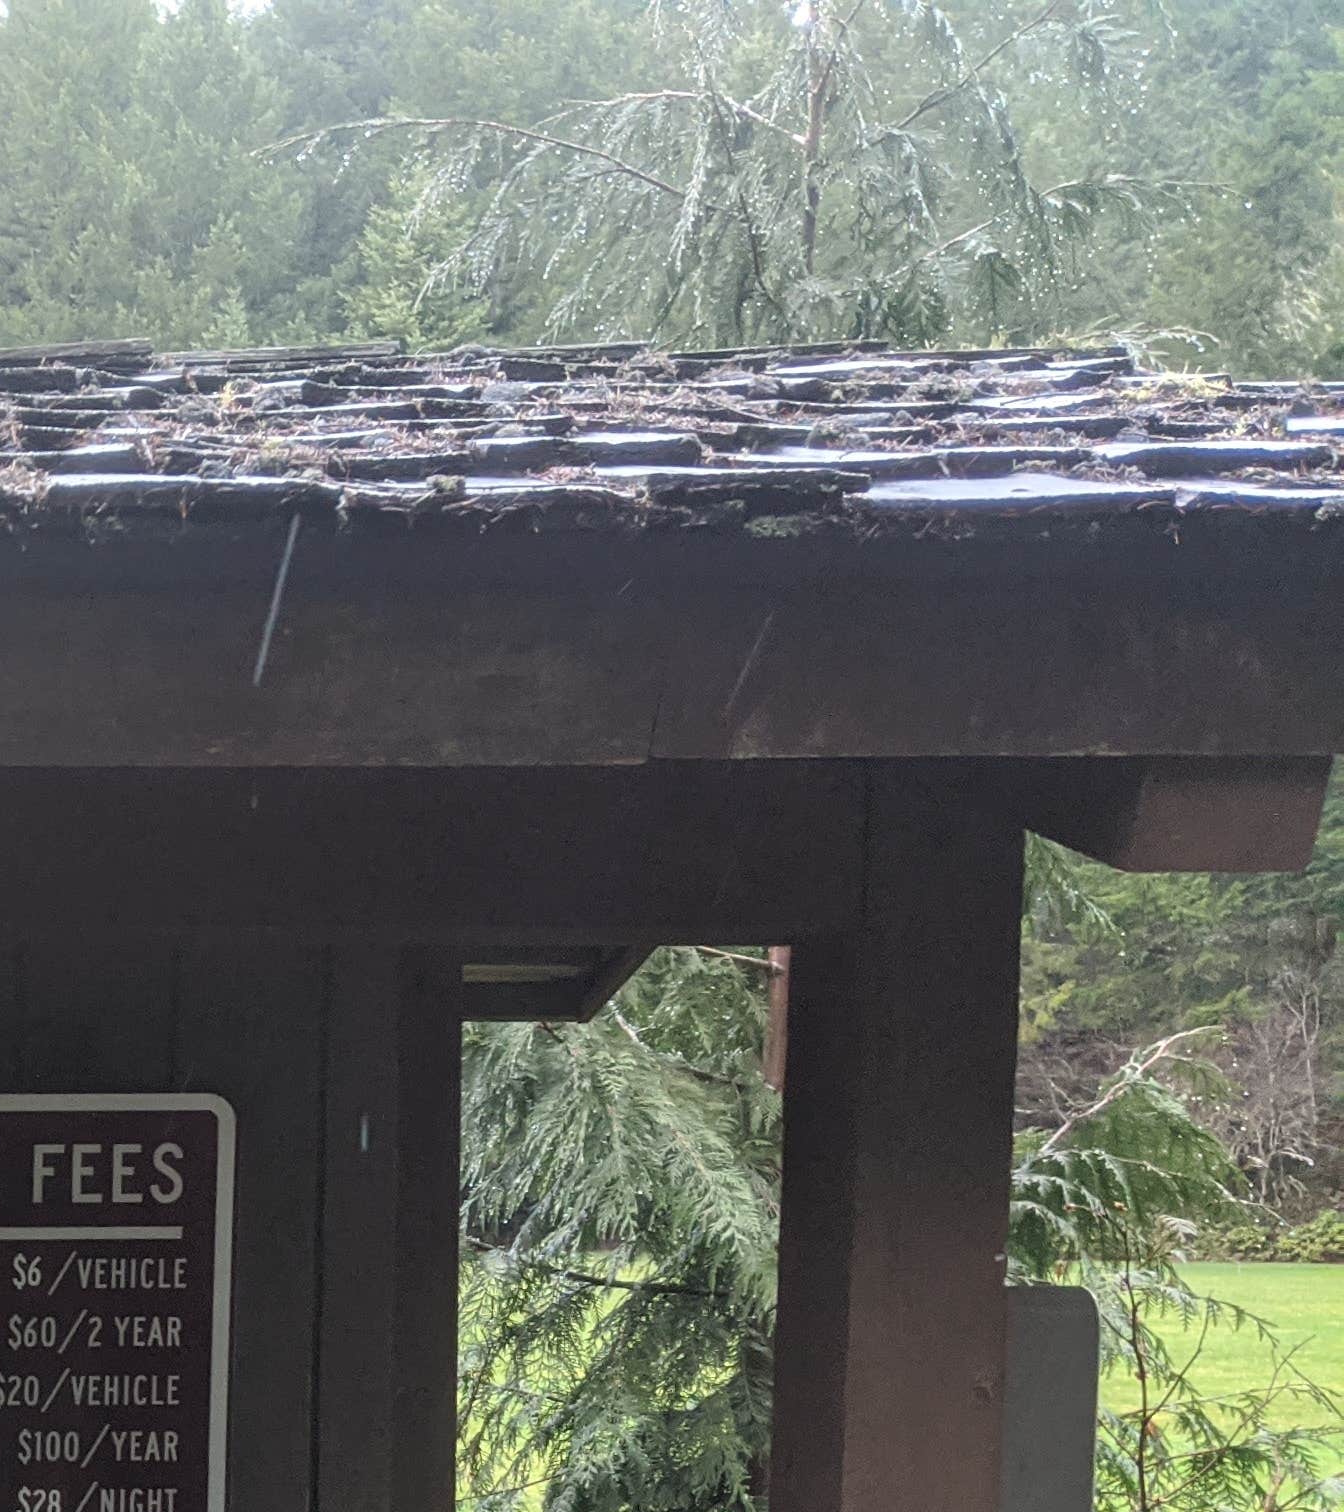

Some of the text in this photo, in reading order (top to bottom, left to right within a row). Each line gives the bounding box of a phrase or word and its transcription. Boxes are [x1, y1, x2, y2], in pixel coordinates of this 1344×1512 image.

[32, 1143, 185, 1203] FEES
[8, 1309, 103, 1354] $60/2
[114, 1316, 182, 1347] YEAR
[17, 1423, 179, 1468] $100/YEAR
